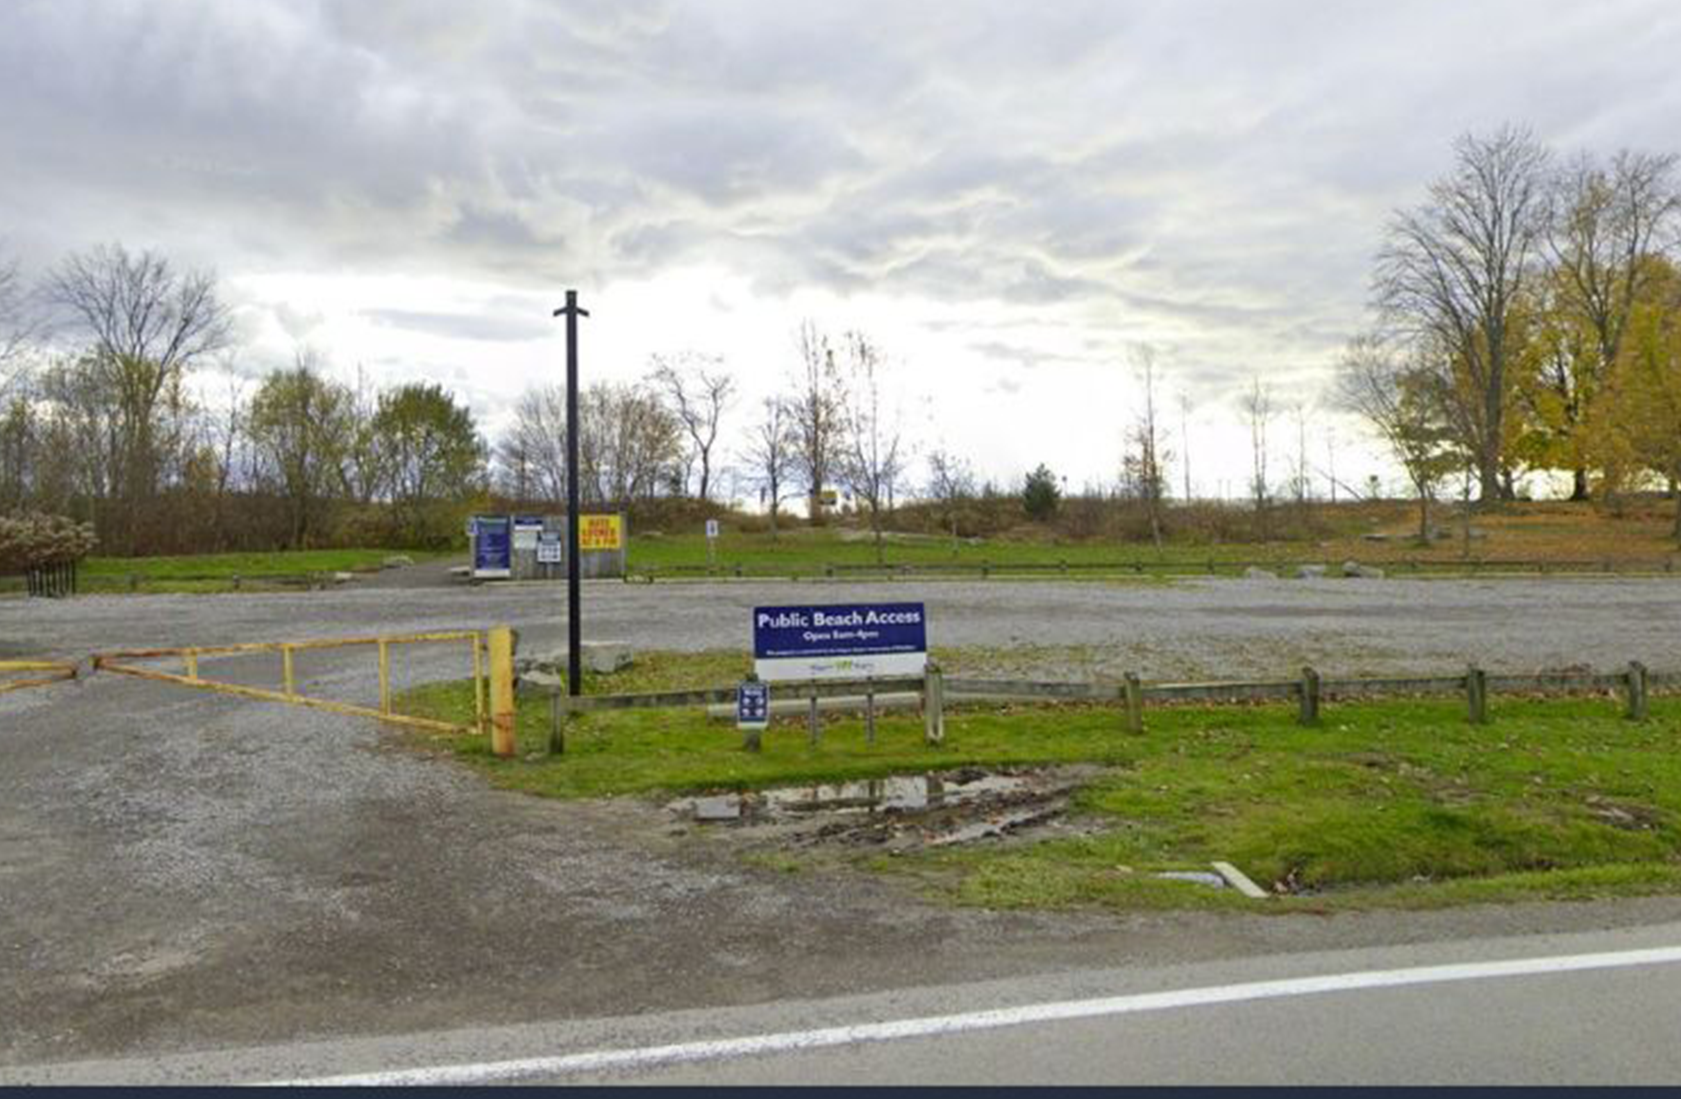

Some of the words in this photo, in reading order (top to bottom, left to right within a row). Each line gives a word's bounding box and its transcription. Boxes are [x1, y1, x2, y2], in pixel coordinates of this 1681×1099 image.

[757, 613, 809, 628] Public
[813, 611, 863, 627] Beach
[866, 610, 922, 625] Access
[802, 631, 831, 642] Open
